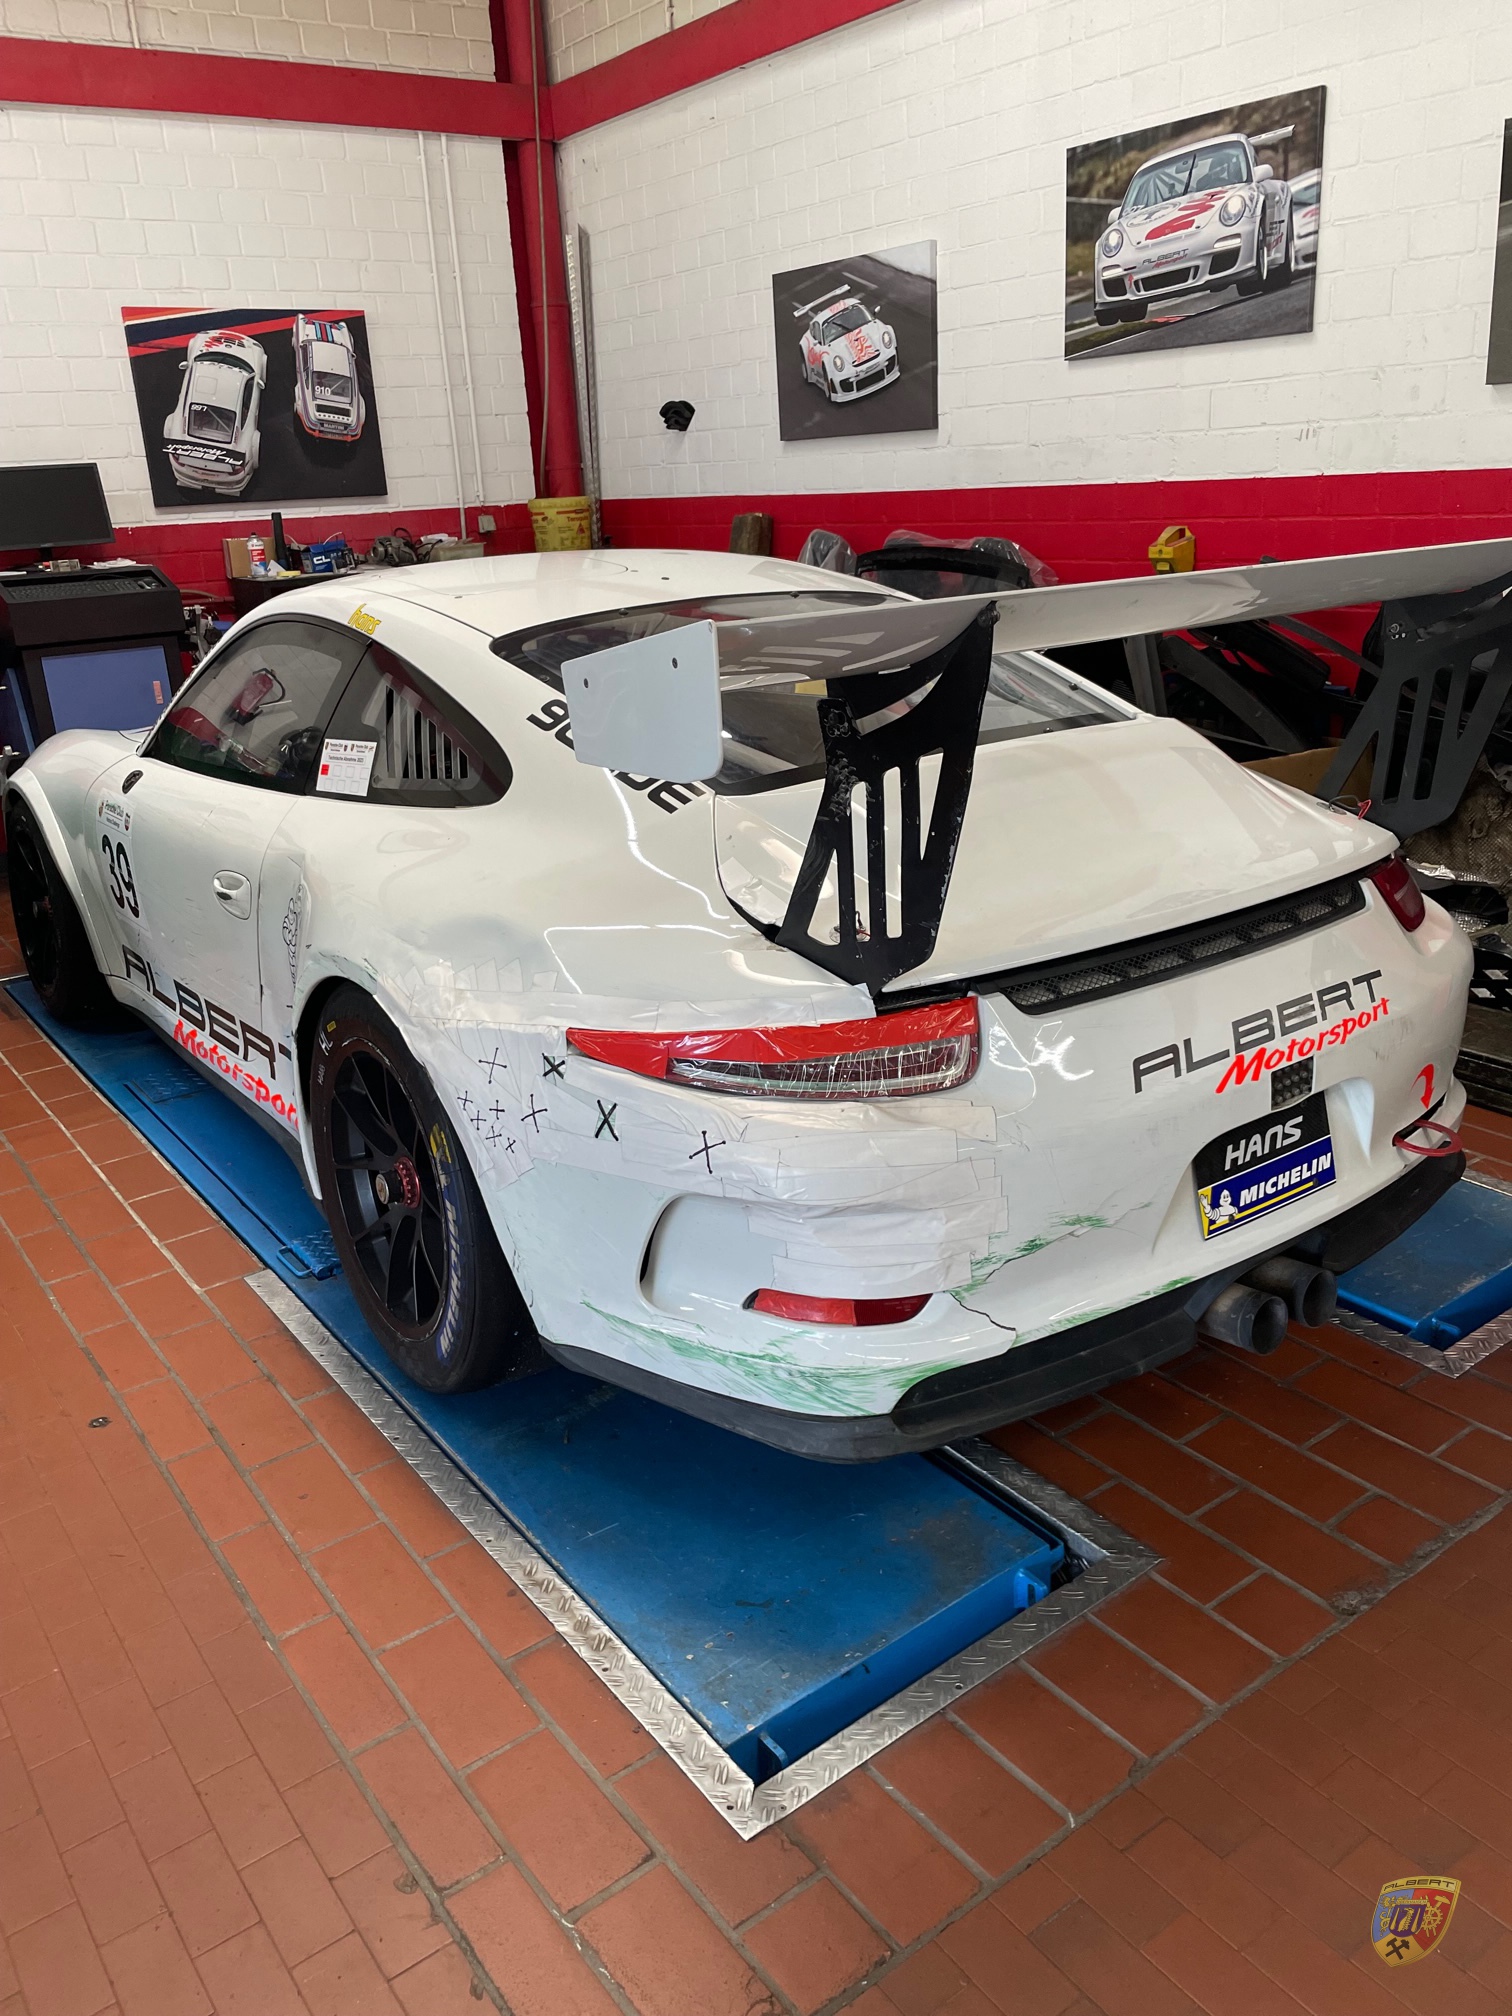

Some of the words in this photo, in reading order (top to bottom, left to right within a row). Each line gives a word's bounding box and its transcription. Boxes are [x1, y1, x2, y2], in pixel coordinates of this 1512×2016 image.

[315, 385, 331, 396] 910
[162, 448, 243, 466] ALBERT
[101, 834, 140, 919] 39
[122, 945, 292, 1081] ALBER
[1132, 970, 1382, 1094] ALBERT
[1215, 996, 1390, 1094] Motorsport
[173, 1019, 298, 1132] Motorspor
[1238, 1152, 1332, 1208] MICHELIN
[439, 1201, 465, 1360] MICHELIN
